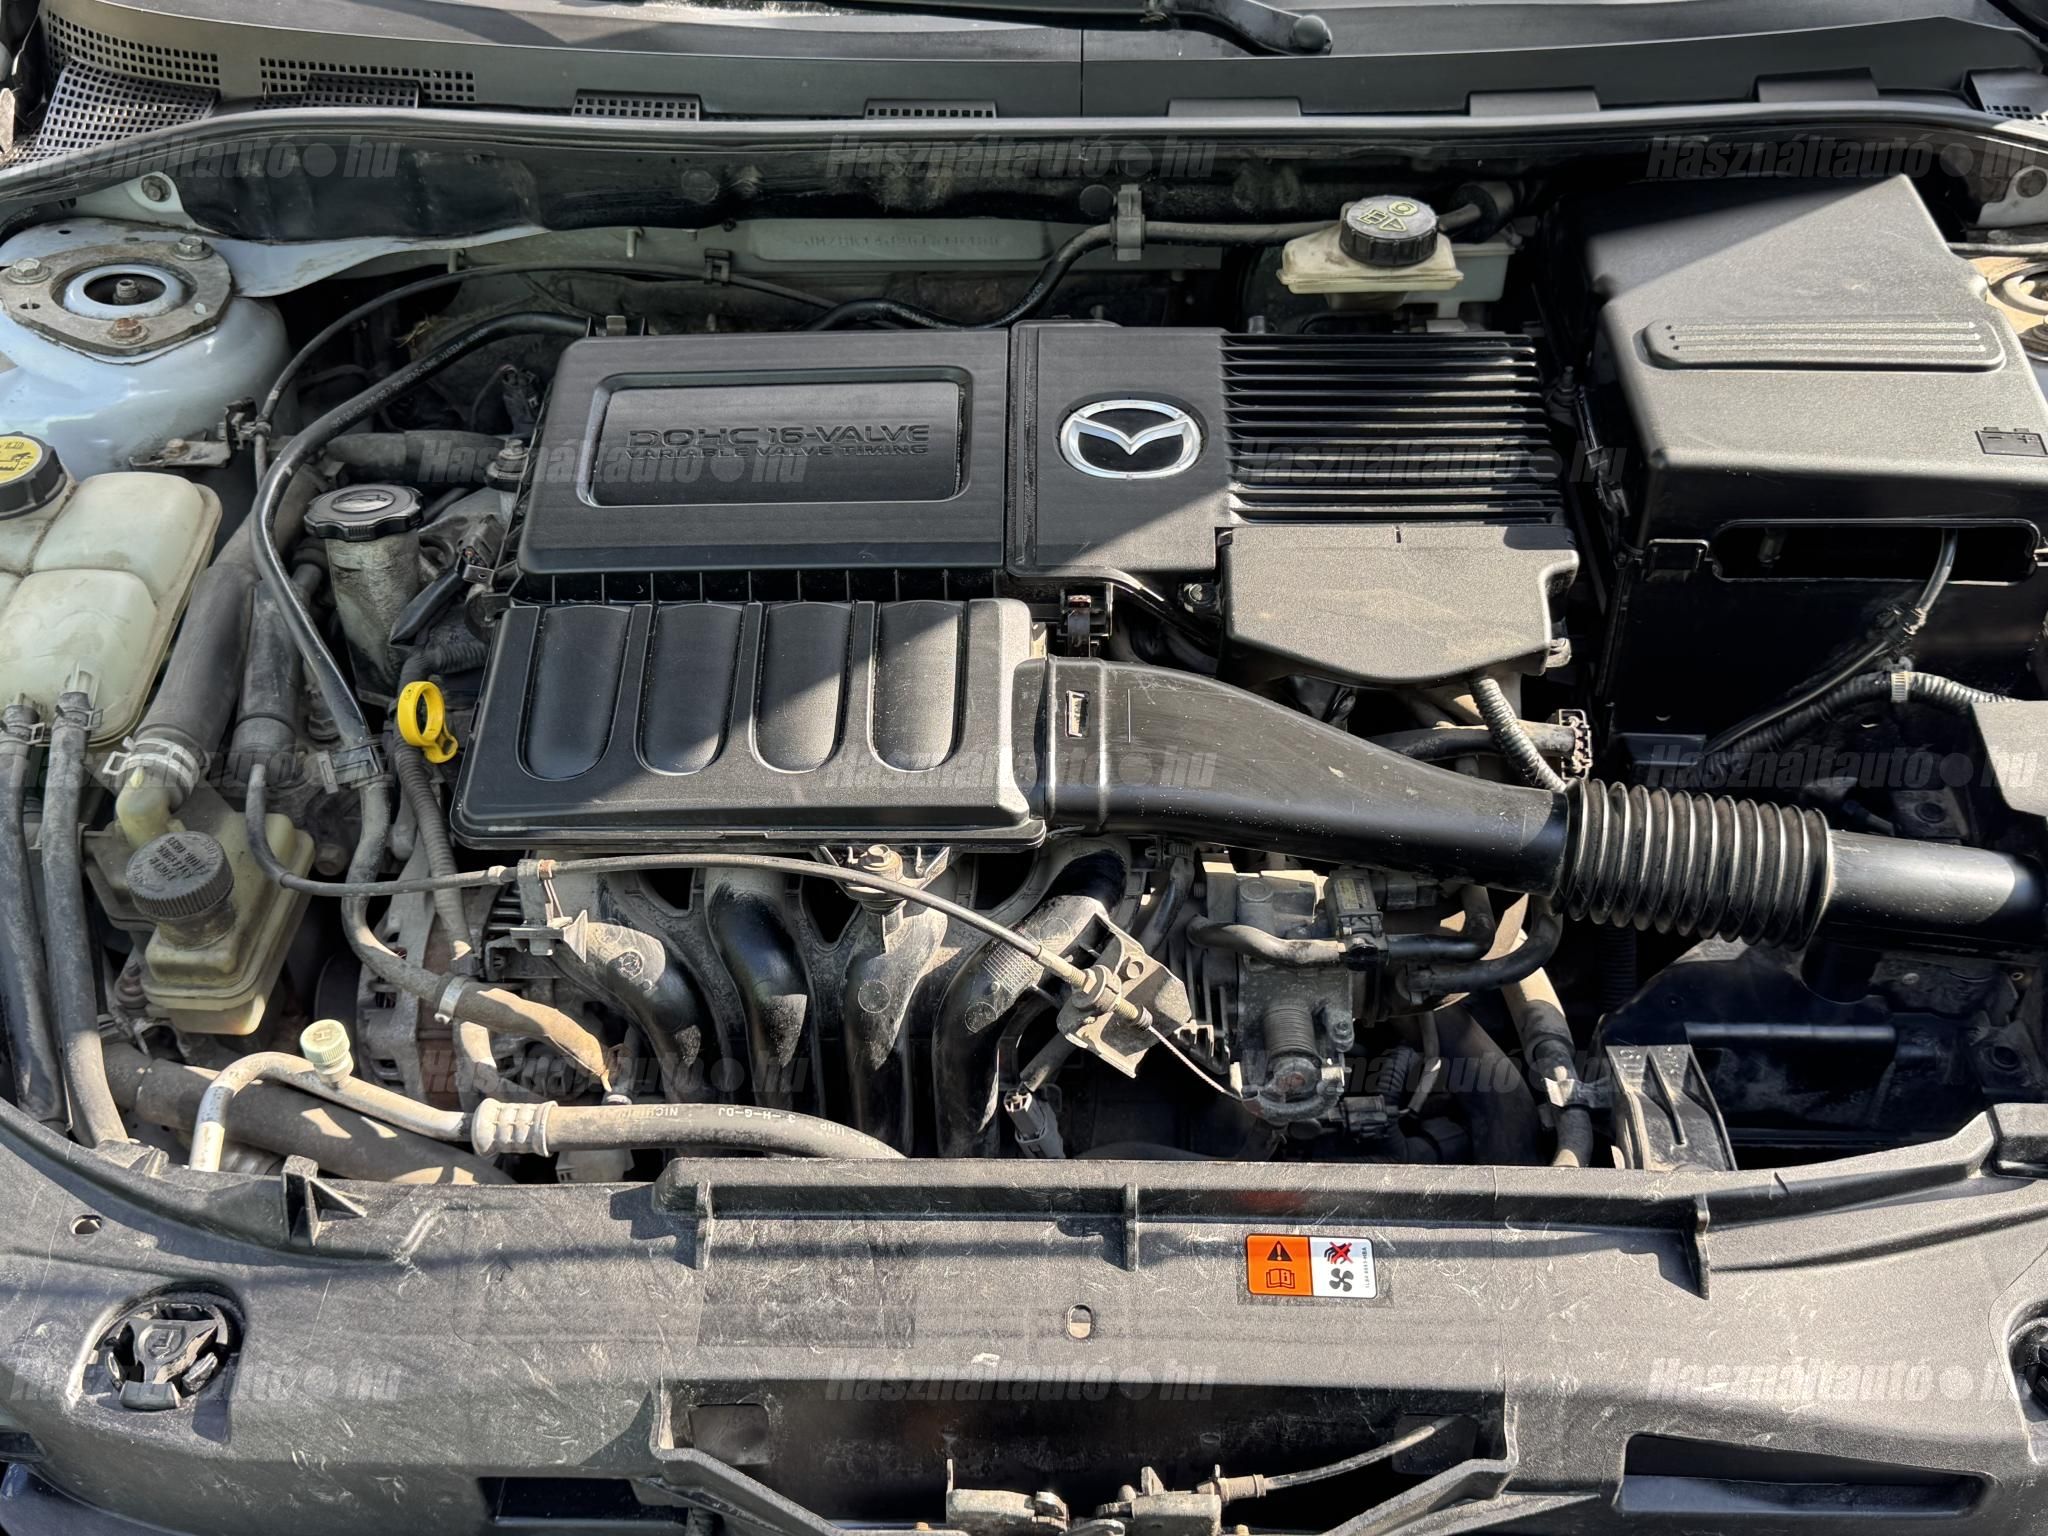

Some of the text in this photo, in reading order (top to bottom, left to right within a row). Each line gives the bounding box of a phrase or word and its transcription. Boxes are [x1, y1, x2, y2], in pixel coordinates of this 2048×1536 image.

[627, 425, 930, 448] DOHC 16-VALVE
[625, 443, 929, 460] VARIABLE VALVE TIMING
